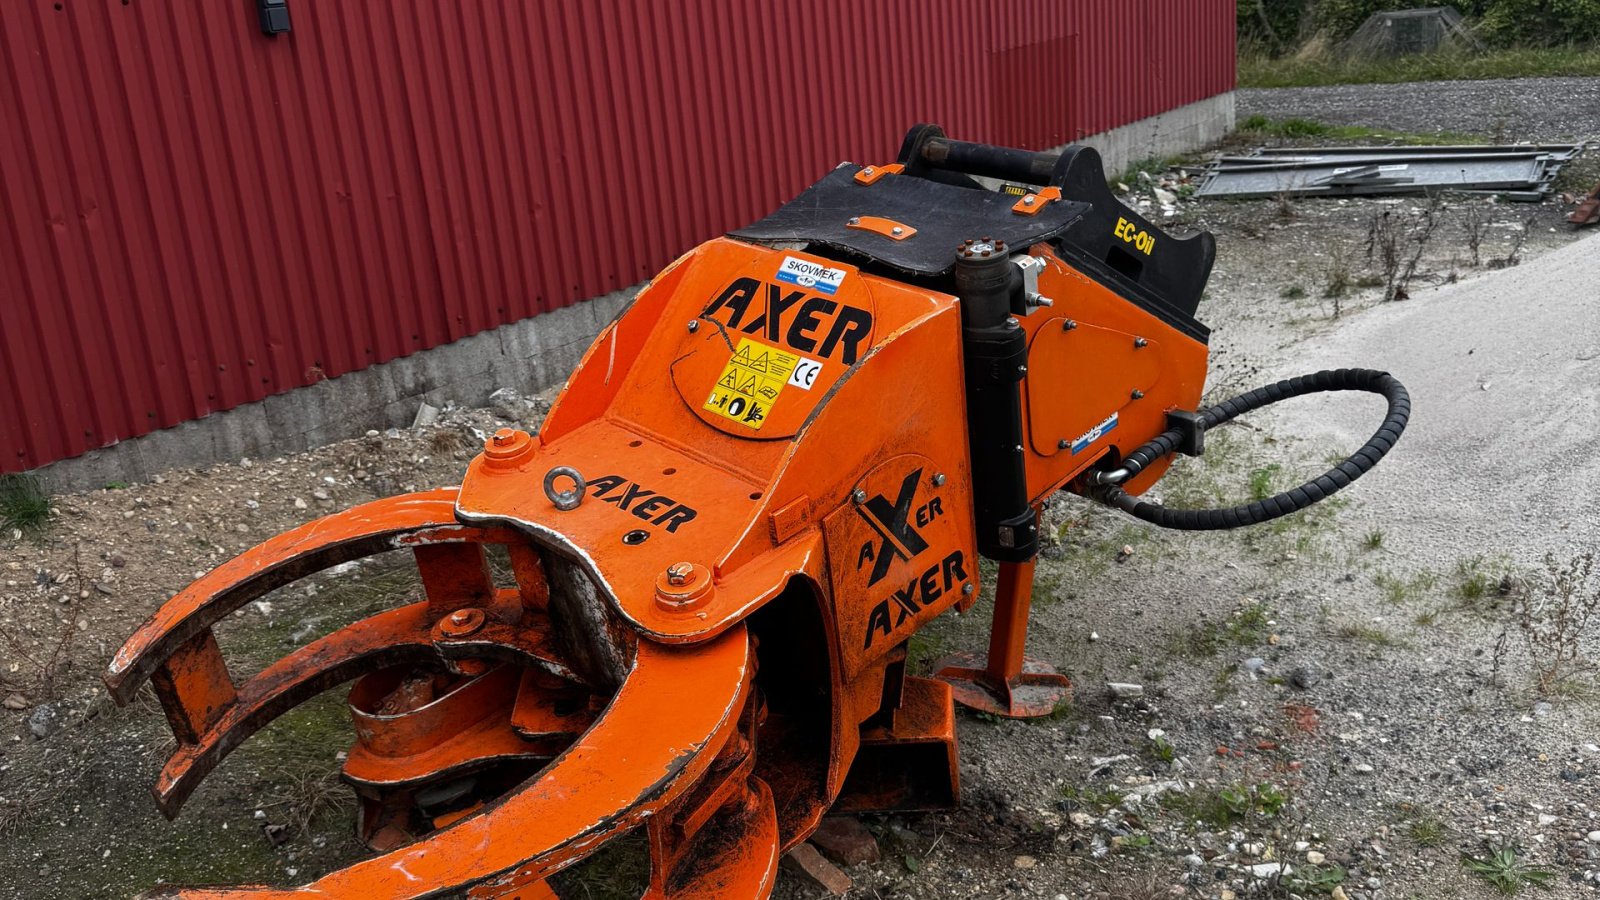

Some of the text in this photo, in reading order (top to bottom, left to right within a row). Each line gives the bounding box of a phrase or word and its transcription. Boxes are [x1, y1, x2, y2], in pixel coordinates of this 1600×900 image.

[1114, 216, 1156, 256] EC-Oil
[787, 260, 837, 281] SKOVMEK
[698, 277, 873, 366] AXER
[574, 475, 698, 534] AXER
[864, 550, 968, 651] AXER
